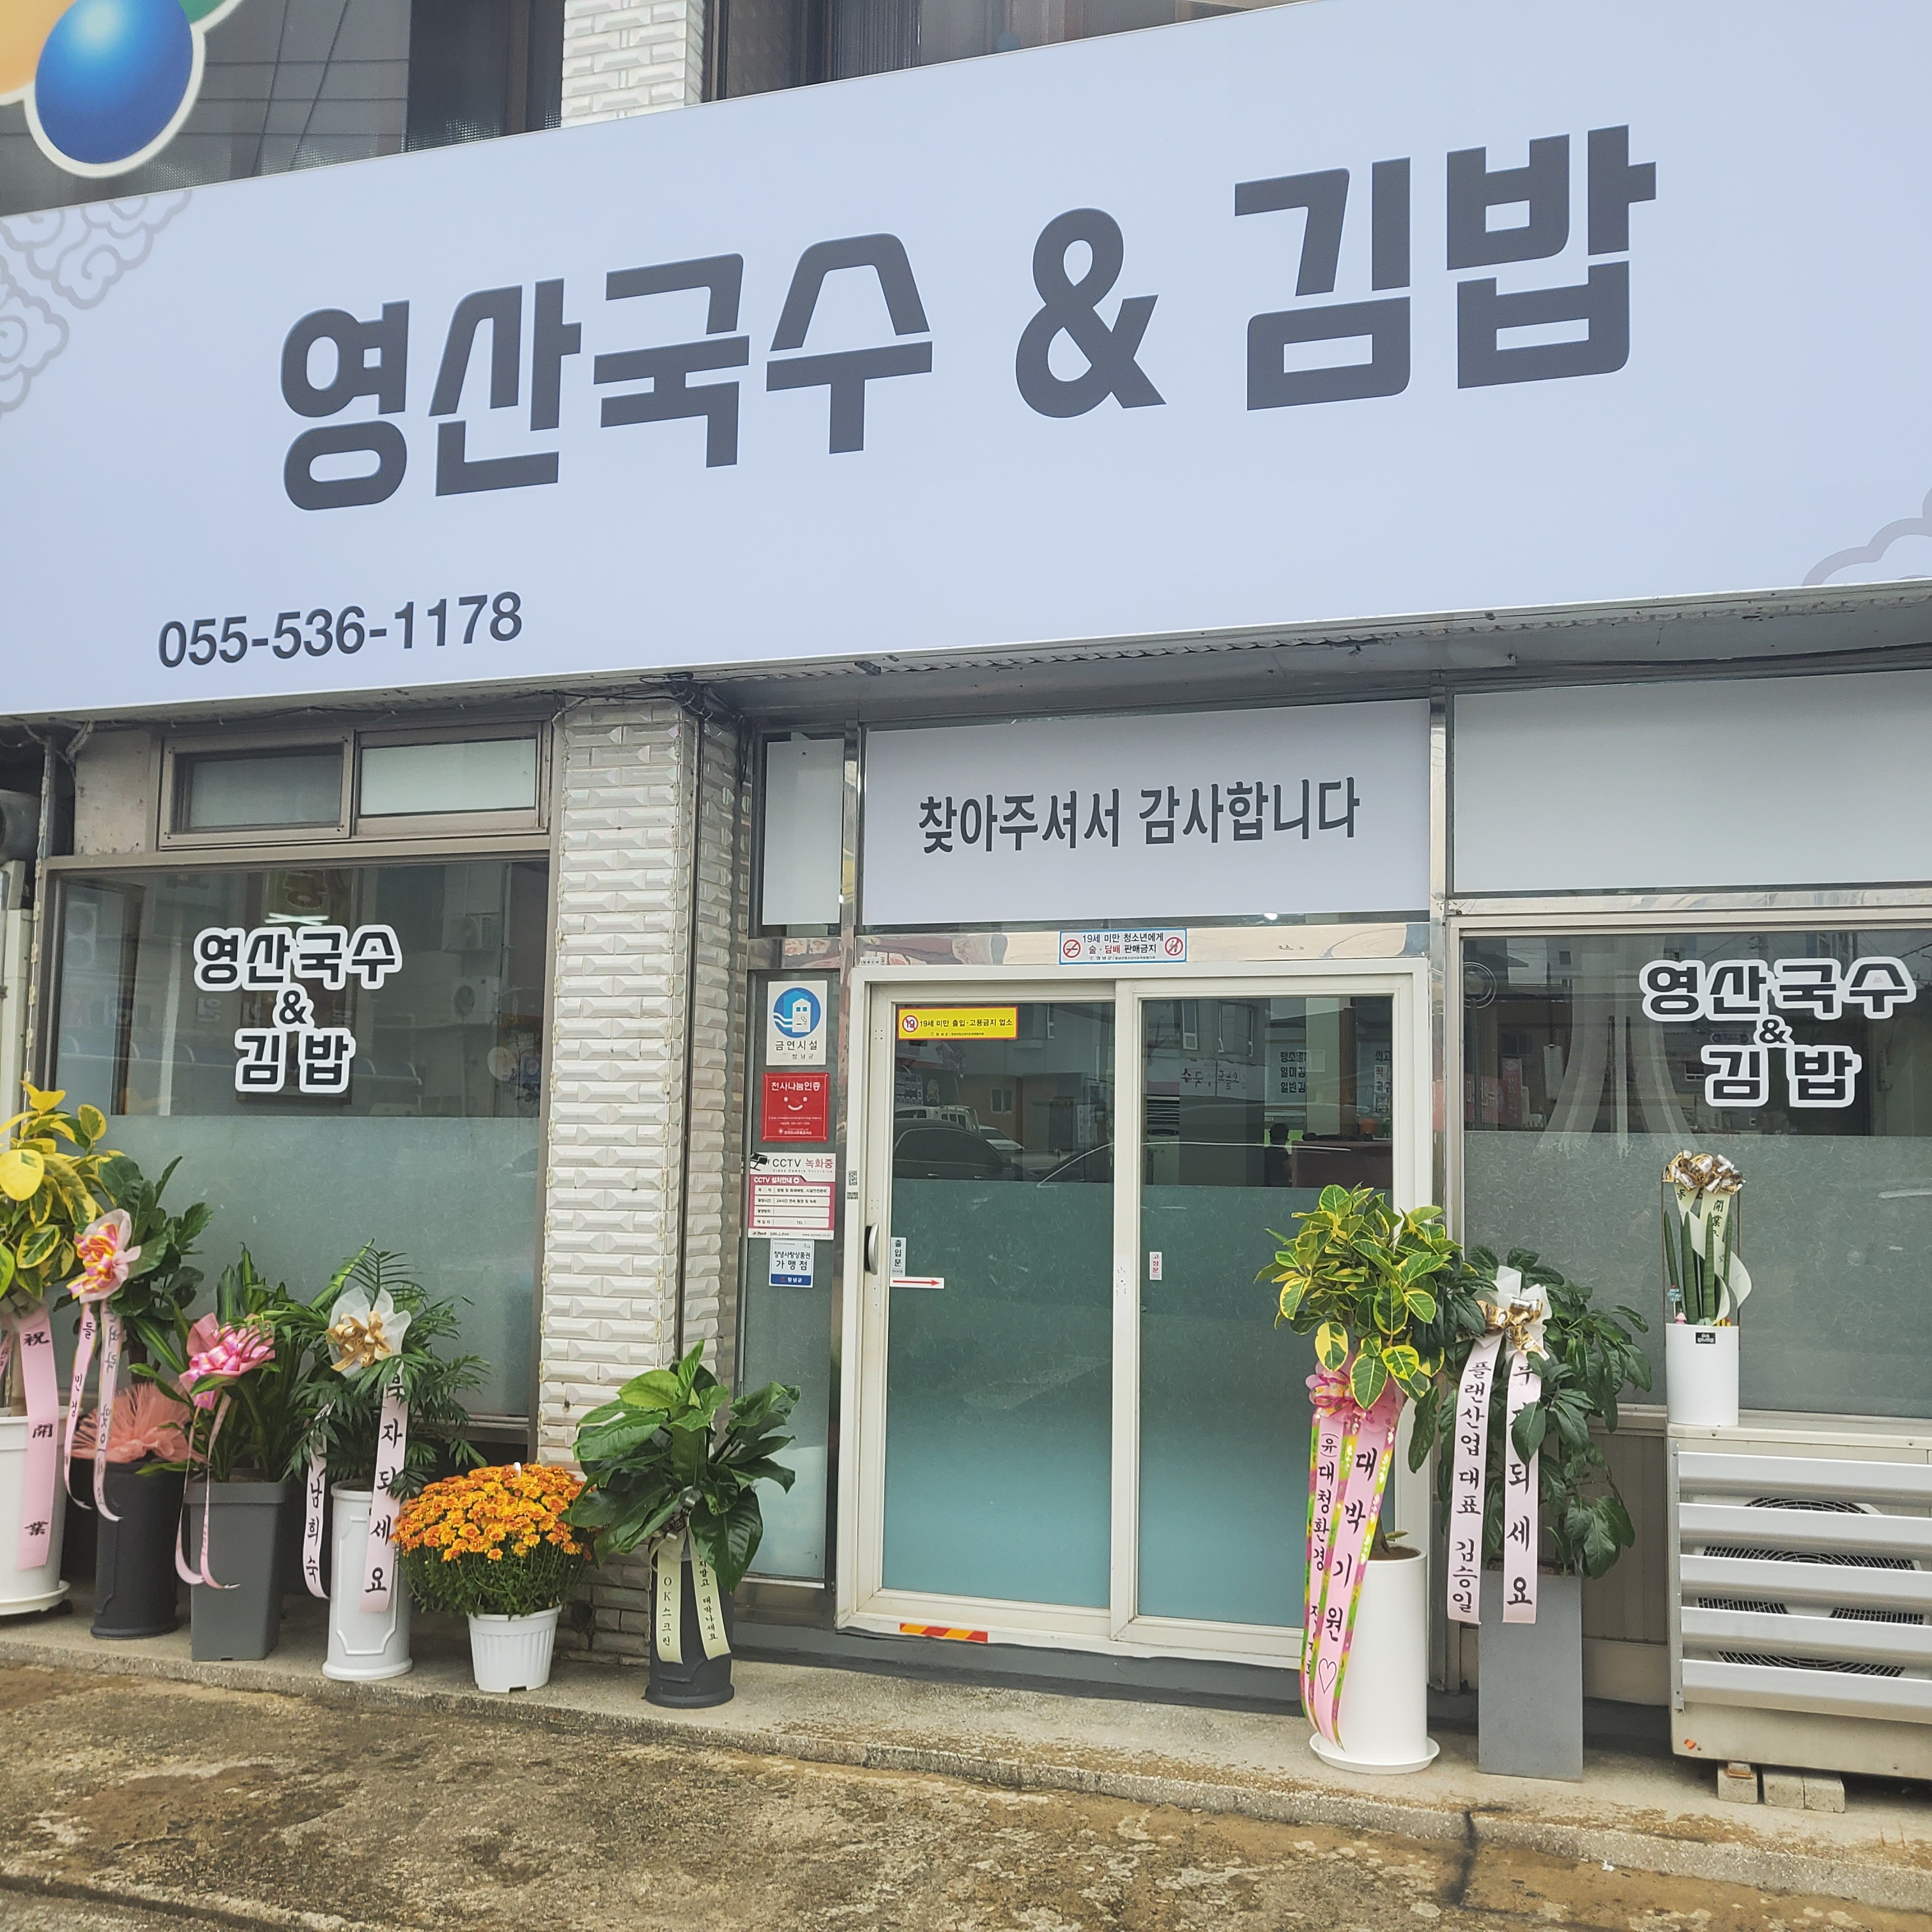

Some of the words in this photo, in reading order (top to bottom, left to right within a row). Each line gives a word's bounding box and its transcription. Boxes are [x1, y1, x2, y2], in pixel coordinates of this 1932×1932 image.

[280, 232, 932, 510] 영산국수
[1016, 208, 1167, 418] &
[1234, 124, 1657, 411] 김밥
[158, 591, 523, 668] 055-536-1178
[919, 787, 1119, 854] 찾아주셔서
[1139, 776, 1360, 845] 감사합니다
[1082, 935, 1100, 943] 19세
[1104, 933, 1120, 942] 미만
[1123, 932, 1164, 942] 청소년에게
[1105, 944, 1121, 954] 담배
[1124, 944, 1157, 953] 판매금지
[197, 928, 399, 988] 영산국수
[1644, 960, 1910, 1017] 영산국수
[279, 990, 310, 1025] &
[775, 1040, 817, 1051] 금연시설
[1759, 1018, 1790, 1043] &
[771, 1082, 821, 1091] 천사나눔인증
[1705, 1049, 1856, 1102] 김밥
[772, 1158, 802, 1168] CCTV
[805, 1158, 834, 1169] 녹화중
[776, 1259, 808, 1271] 가맹점
[1506, 1361, 1533, 1606] 부되세요
